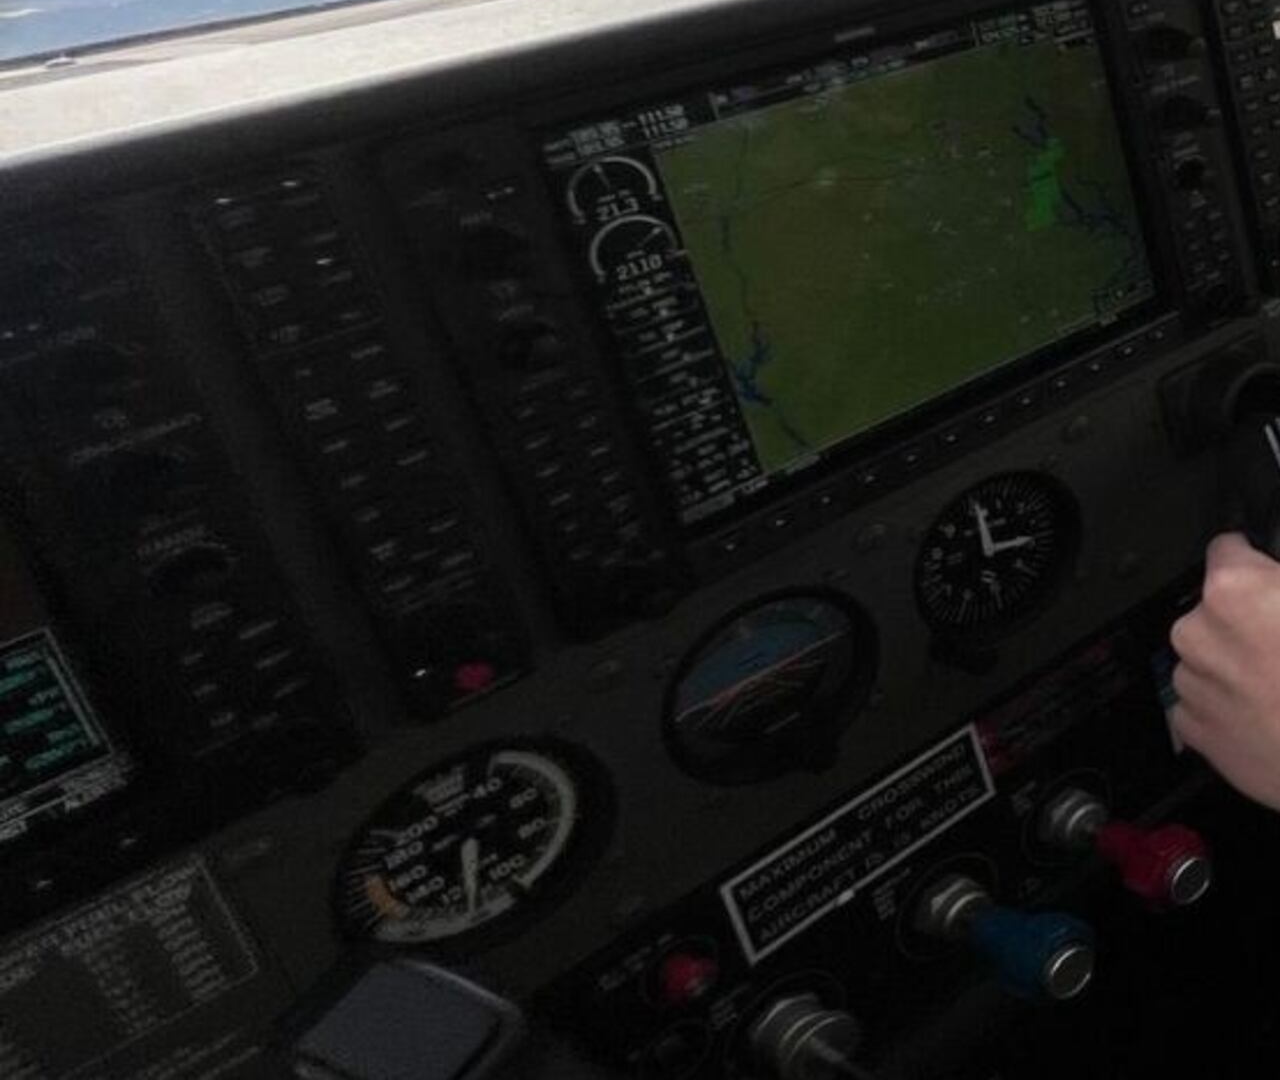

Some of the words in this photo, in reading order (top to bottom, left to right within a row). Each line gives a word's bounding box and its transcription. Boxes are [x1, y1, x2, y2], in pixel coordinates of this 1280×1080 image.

[616, 253, 663, 281] 2110
[472, 776, 504, 798] 40
[489, 853, 526, 881] 100
[738, 827, 838, 901] MAXIMUM
[747, 828, 873, 923] COMPONENT
[760, 867, 857, 942] AIRCRAFT
